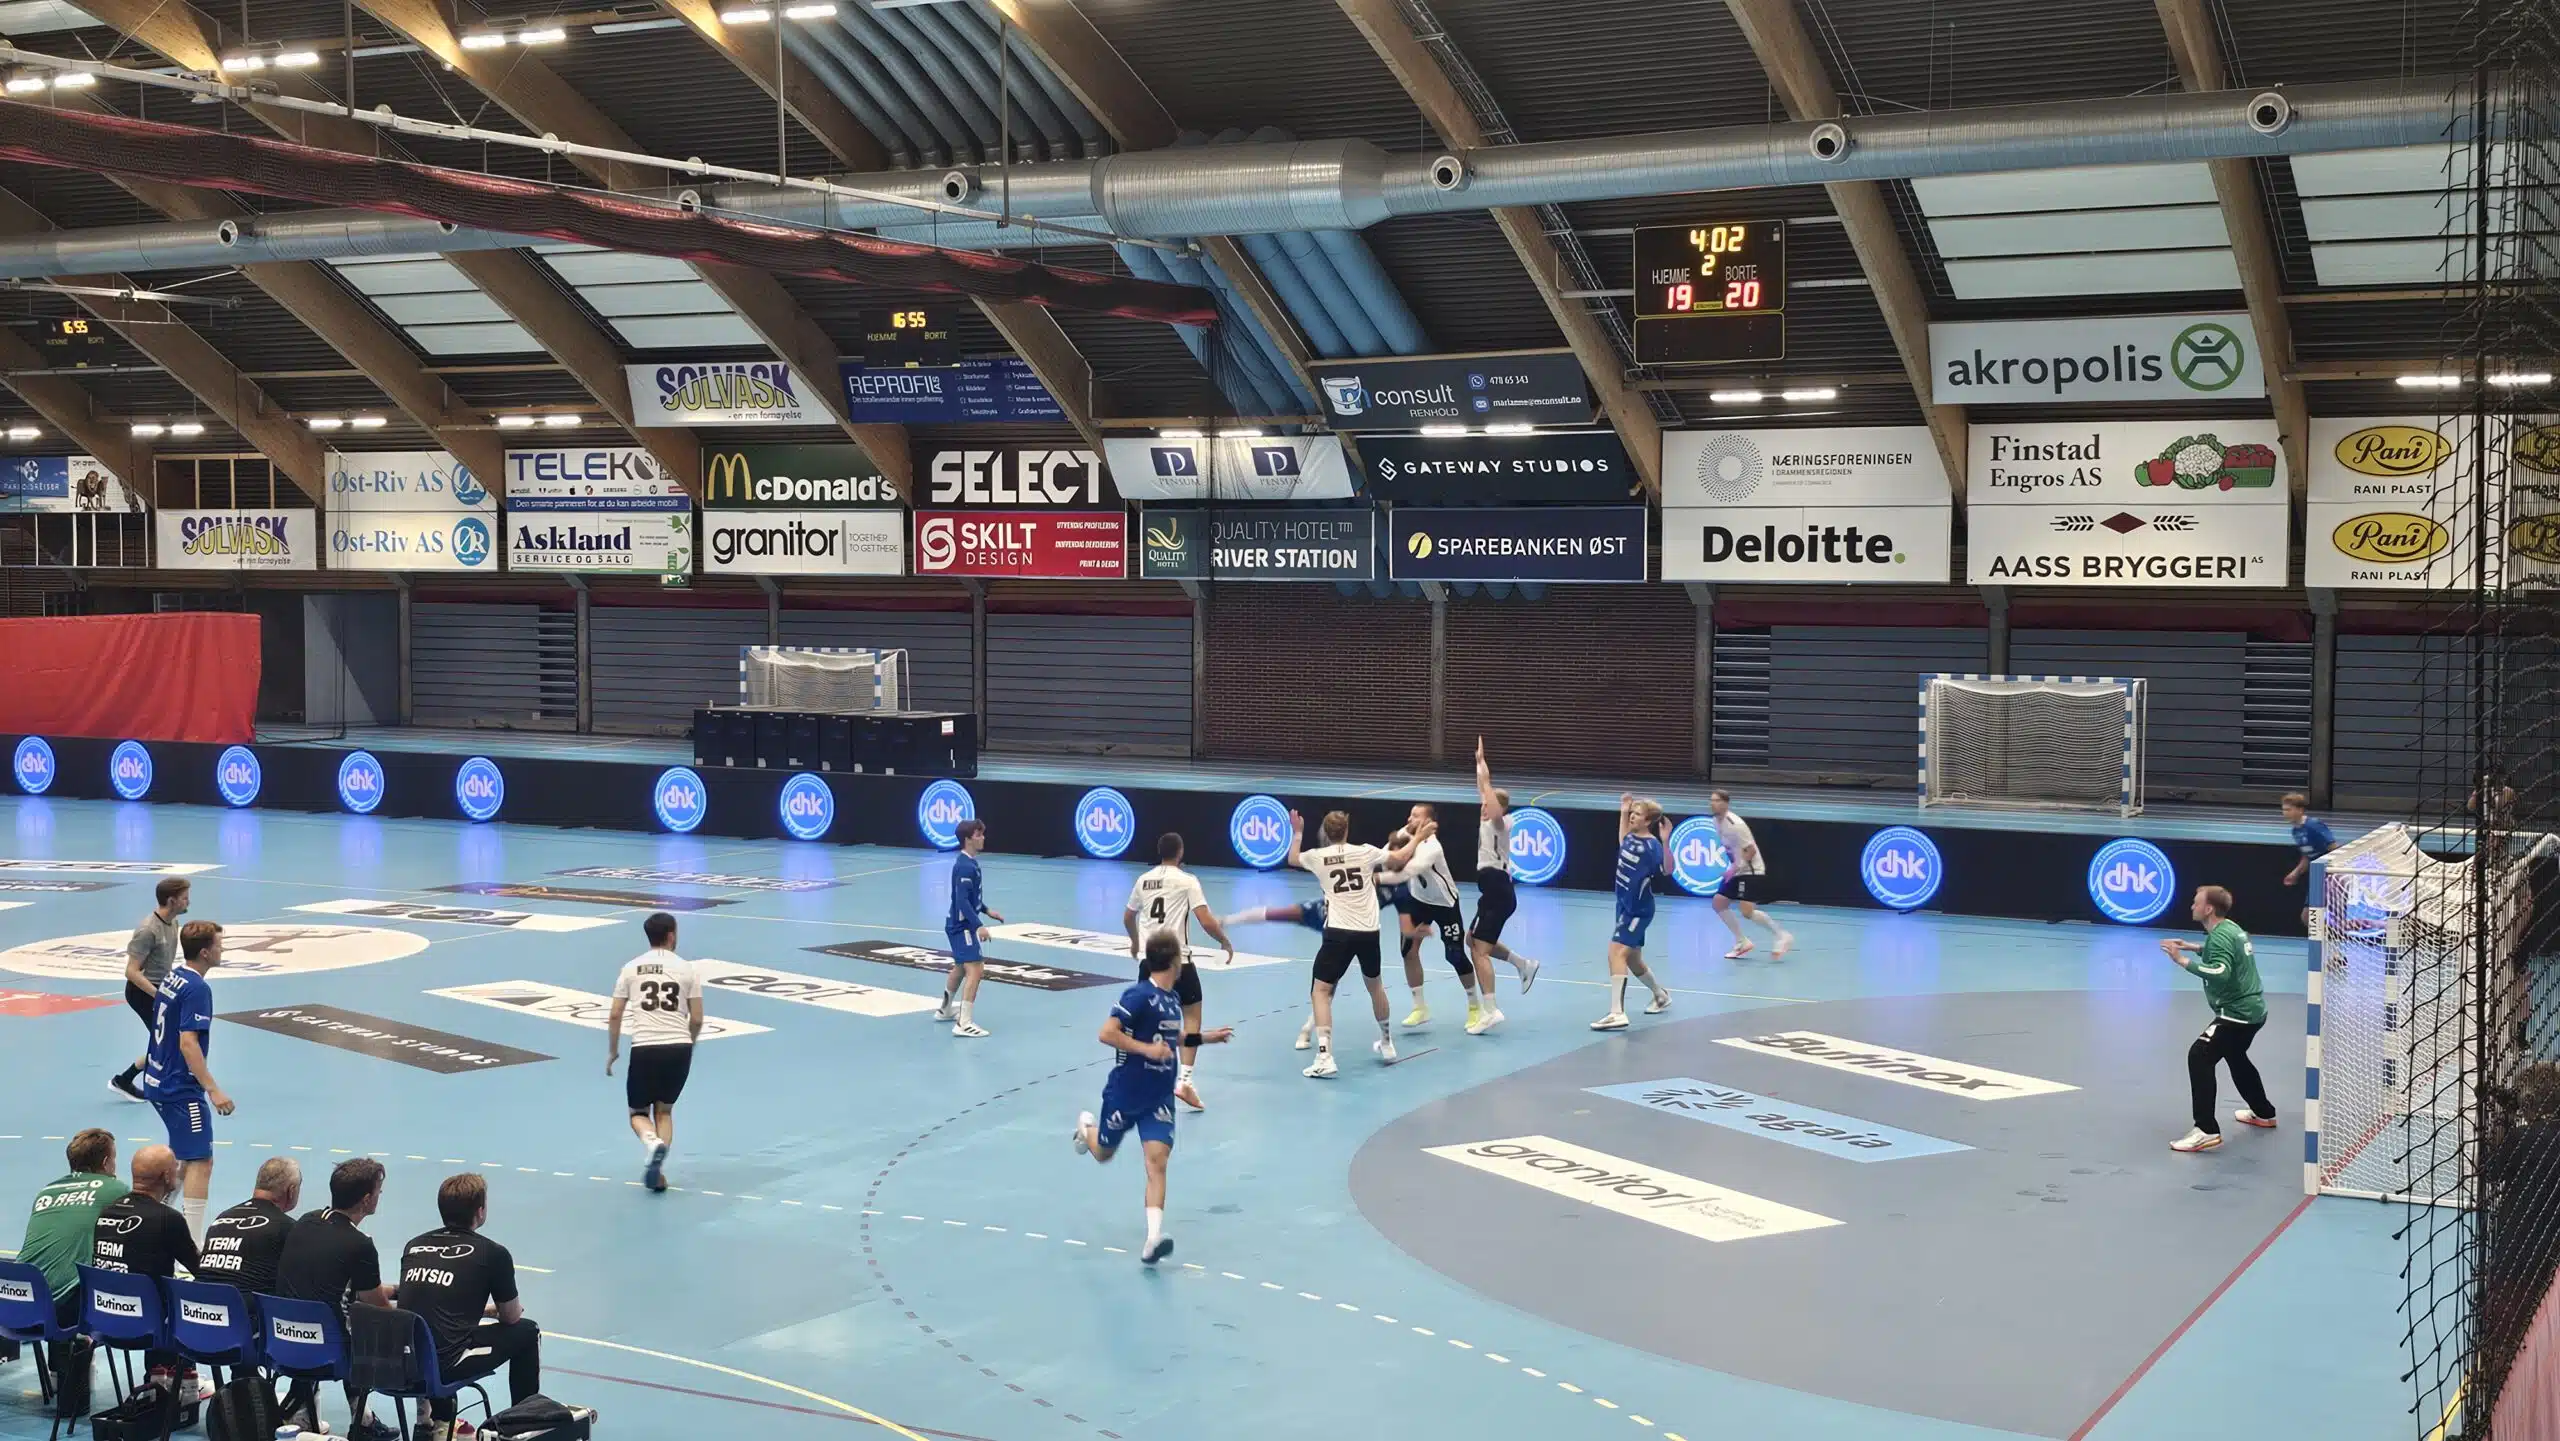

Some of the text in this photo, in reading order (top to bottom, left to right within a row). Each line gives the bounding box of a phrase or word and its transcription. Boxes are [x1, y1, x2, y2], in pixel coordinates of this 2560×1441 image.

[1652, 265, 1757, 284] HJEMME BORTE
[1701, 254, 1716, 276] 2
[1667, 281, 1760, 310] 19 20
[867, 331, 948, 342] HJEMME BORTE
[1948, 344, 2163, 395] akropolis
[655, 364, 800, 411] SOLVASK
[1375, 384, 1455, 406] consult
[1410, 408, 1459, 418] RENHOLD
[1772, 453, 1912, 466] NÆRINGSFORENINGEN
[1990, 434, 2101, 462] Finstad
[2353, 434, 2433, 472] Rani
[931, 450, 1101, 503] SELECT
[1404, 459, 1609, 474] GATEWAY STUDIOS
[1776, 468, 1852, 476] DRAMMENSREGIONEN
[332, 469, 408, 494] Øst-Riv
[414, 471, 443, 493] AS
[1990, 467, 2102, 494] Engros AS
[2354, 485, 2431, 494] RANI PLAST
[181, 516, 291, 556] SOLVASK
[332, 527, 443, 553] Øst-Riv AS
[513, 525, 632, 550] Askland
[712, 521, 838, 564] granitor
[850, 533, 888, 542] TOGETHER
[961, 523, 1037, 550] SKILT
[1211, 522, 1280, 543] QUALITY
[2350, 521, 2432, 558] Rani
[516, 554, 630, 563] SERVICE OG SALG
[850, 544, 860, 552] TO
[967, 552, 1033, 565] DESIGN
[1149, 550, 1187, 561] QUALITY
[1438, 536, 1627, 556] SPAREBANKEN ØST
[1212, 549, 1357, 569] RIVER STATION
[1989, 556, 2071, 578] AASS
[2083, 556, 2246, 579] BRYGGERI
[2352, 571, 2430, 581] RANI PLAST
[347, 768, 375, 791] dhk
[465, 774, 495, 799] dhk
[663, 785, 696, 811] dhk
[790, 792, 823, 817] dhk
[929, 798, 962, 824] dhk
[1086, 807, 1123, 833] dhk
[1242, 815, 1281, 842] dhk
[1509, 829, 1552, 857] dhk
[1680, 839, 1728, 867] dhk
[1876, 849, 1926, 880] dhk
[1330, 867, 1364, 894] 25
[2104, 862, 2158, 894] dhk
[1150, 897, 1166, 924] 4
[1444, 923, 1461, 937] 23
[640, 981, 680, 1012] 33
[154, 1002, 168, 1046] 5
[291, 1016, 500, 1065] GATEWAY STUDIOS
[1750, 1036, 2012, 1090] Butinox
[1745, 1113, 1893, 1149] agaia
[1467, 1144, 1696, 1202] granitor
[55, 1190, 97, 1204] REAL
[97, 1241, 124, 1257] TEAM
[208, 1237, 243, 1251] TEAM
[405, 1268, 455, 1287] PHYSIO
[96, 1295, 137, 1313] Butinox
[183, 1304, 223, 1322] Butinox
[276, 1322, 318, 1340] Butinox
